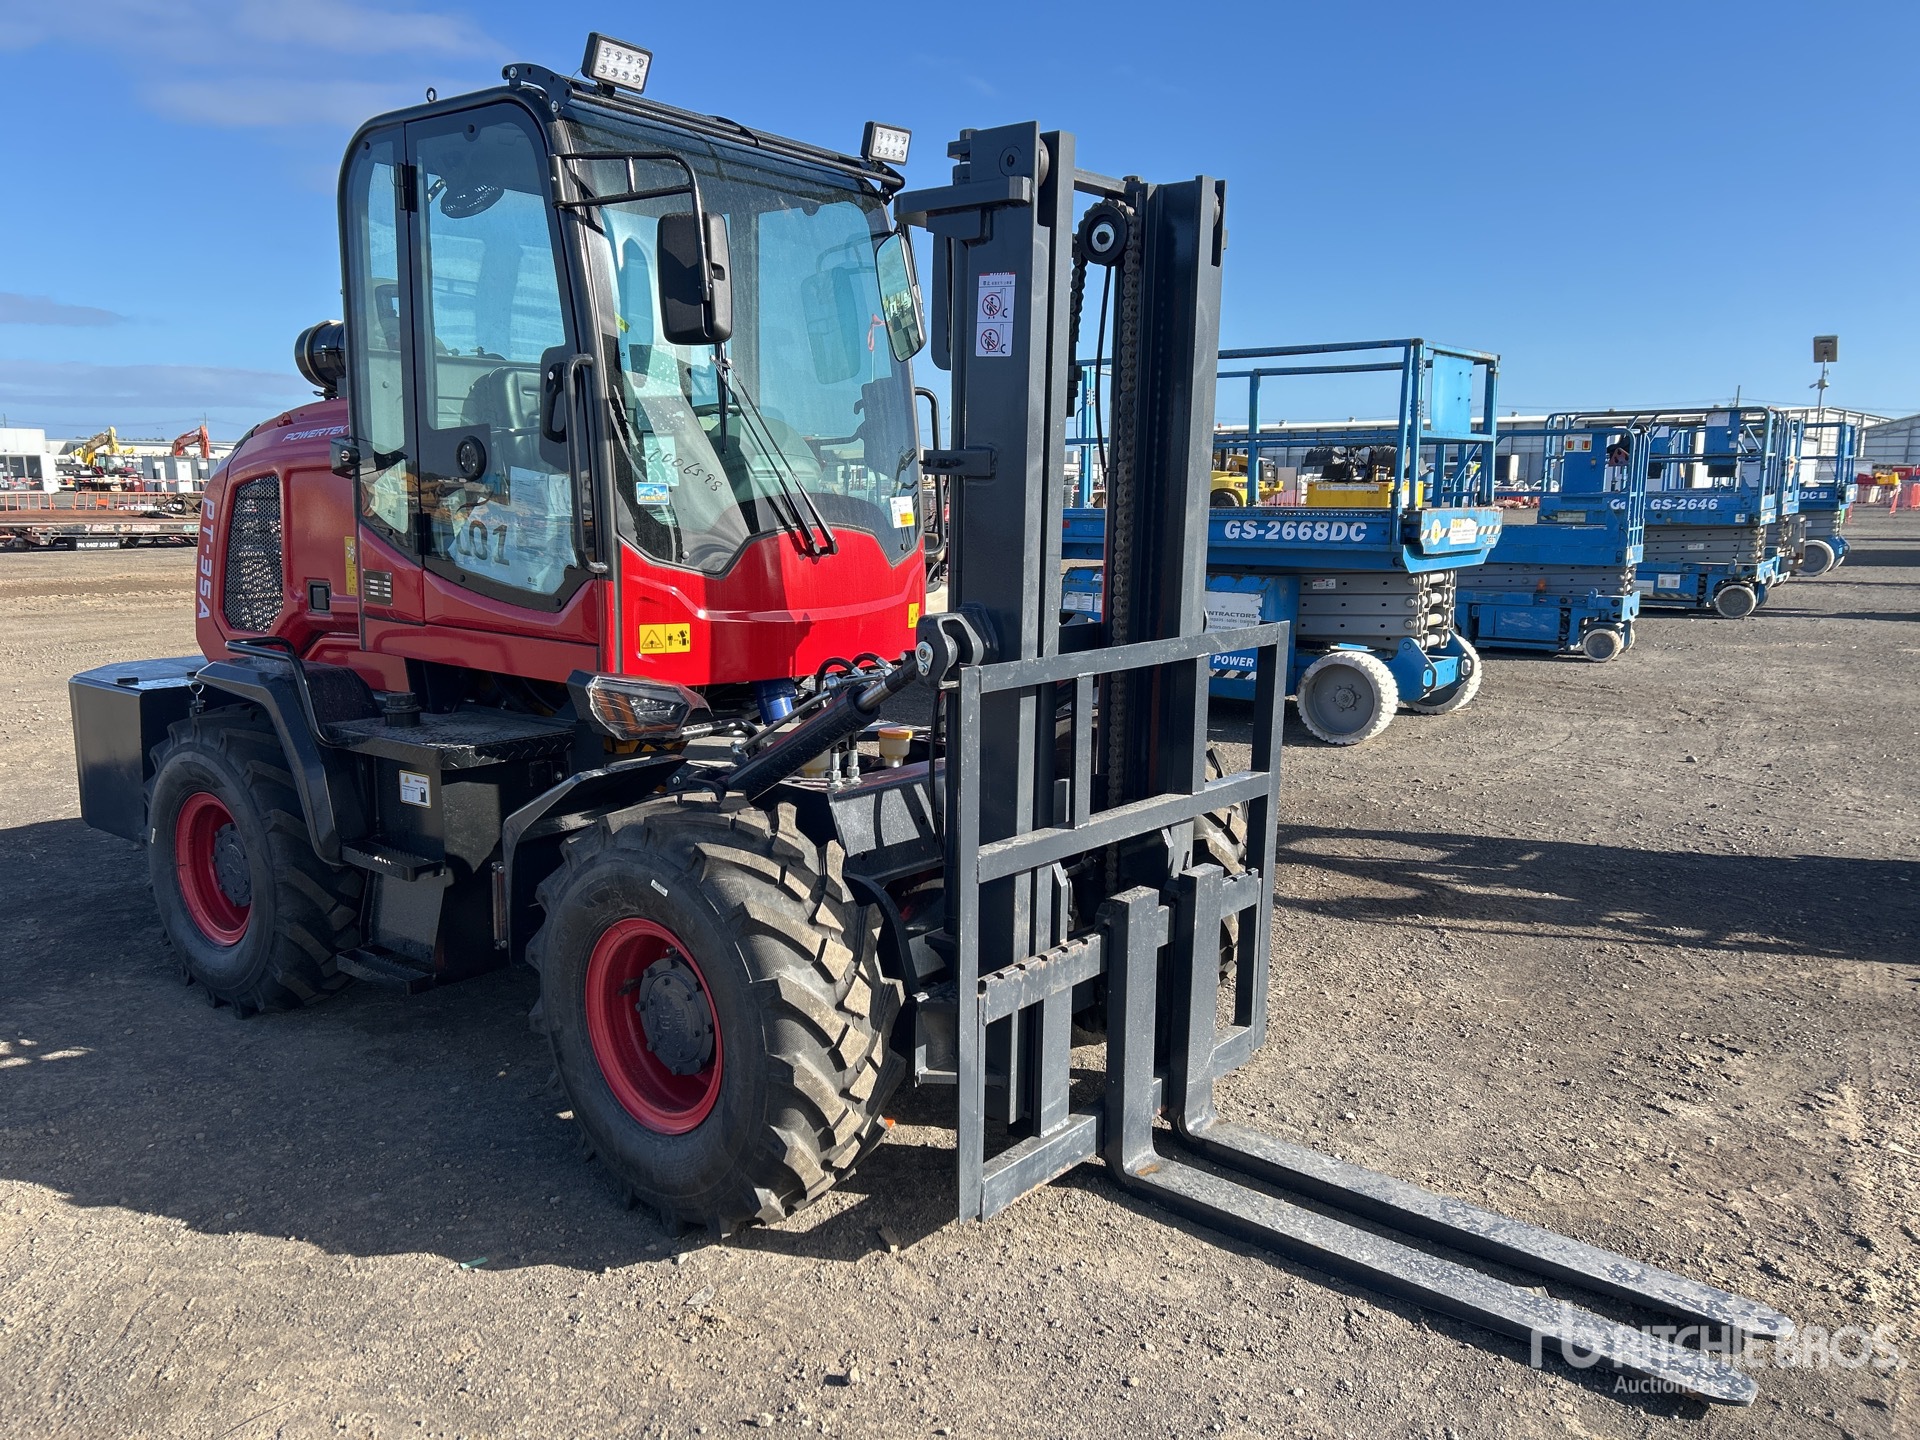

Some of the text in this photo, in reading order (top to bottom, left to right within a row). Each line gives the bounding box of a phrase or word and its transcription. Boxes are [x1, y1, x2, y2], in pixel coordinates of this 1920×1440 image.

[282, 425, 349, 442] POWERTEK
[1650, 498, 1718, 510] GS-2646
[1224, 520, 1368, 542] GS-2668DC
[198, 496, 215, 619] PT-35A
[1207, 610, 1257, 619] NTRACTORS
[1213, 655, 1255, 667] POWER
